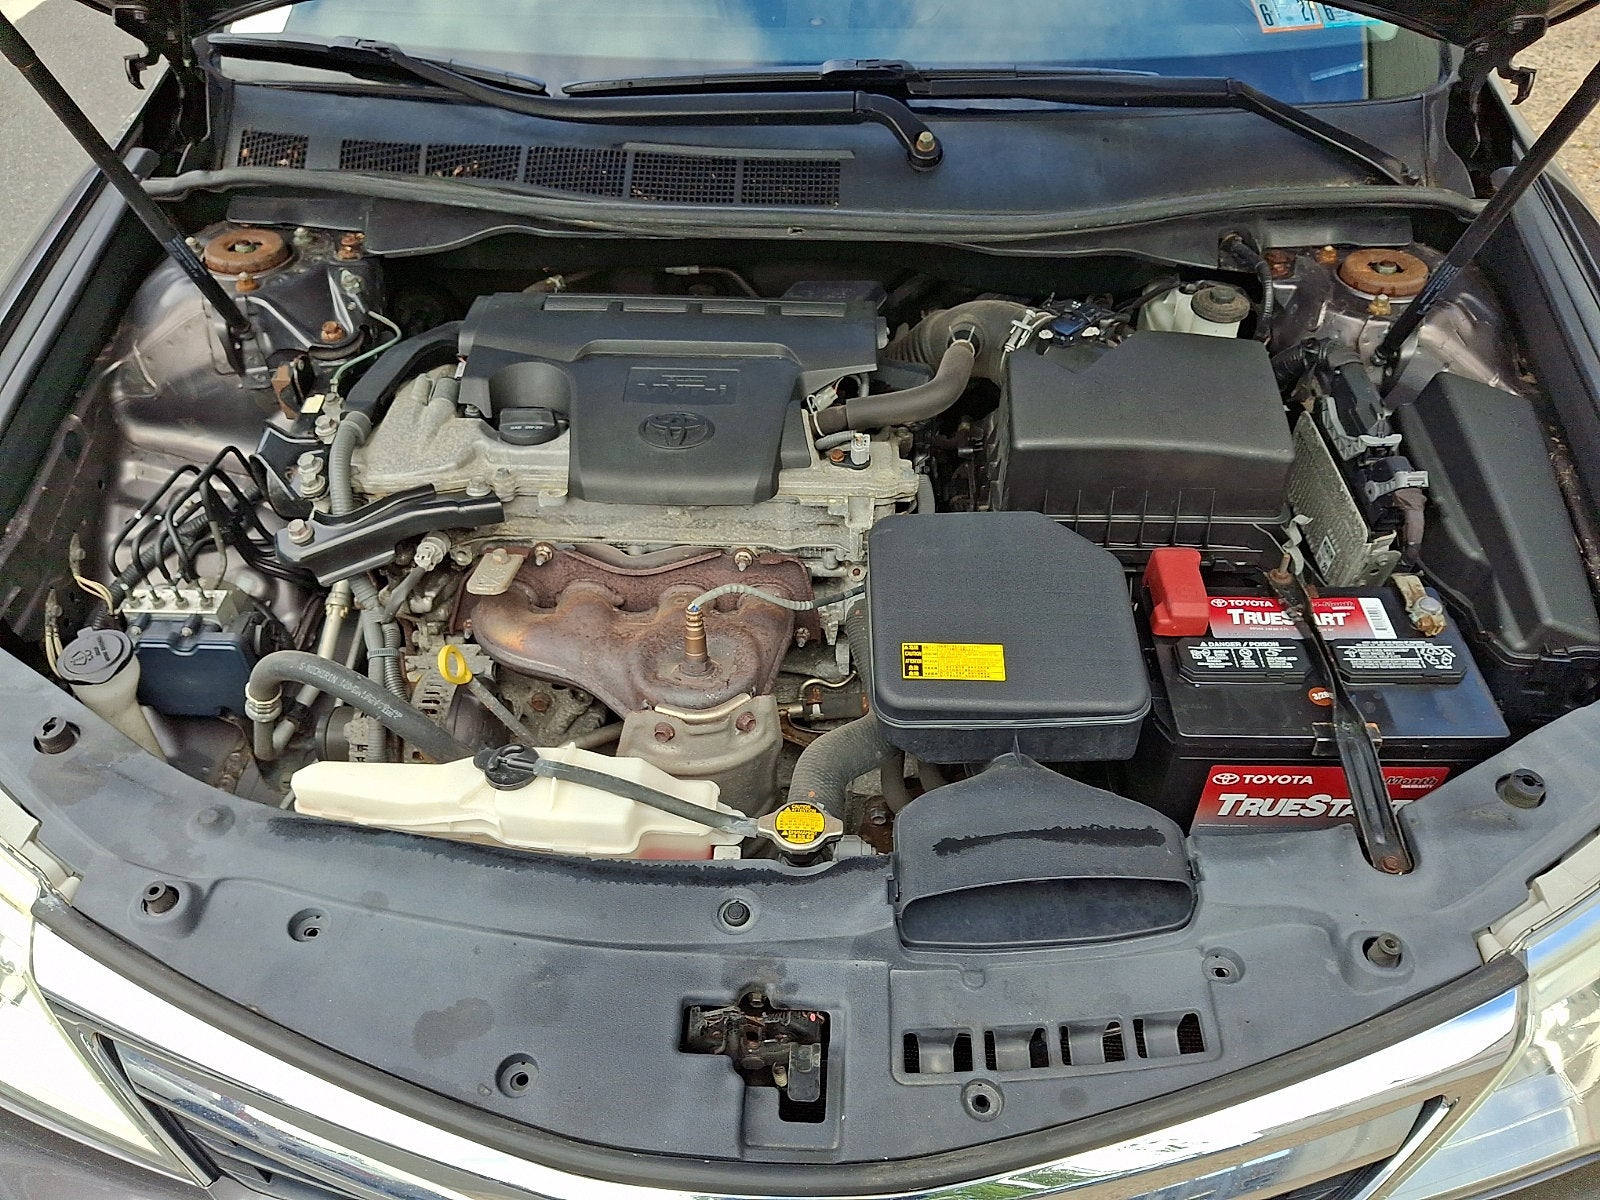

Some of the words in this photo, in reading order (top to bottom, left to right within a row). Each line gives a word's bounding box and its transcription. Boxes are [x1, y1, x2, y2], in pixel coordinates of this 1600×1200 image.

[1259, 3, 1274, 26] 6
[1228, 599, 1274, 608] TOYOTA
[1226, 608, 1347, 626] TRUESRT
[1242, 774, 1314, 785] TOYOTA
[1217, 793, 1414, 818] TRUESTT
